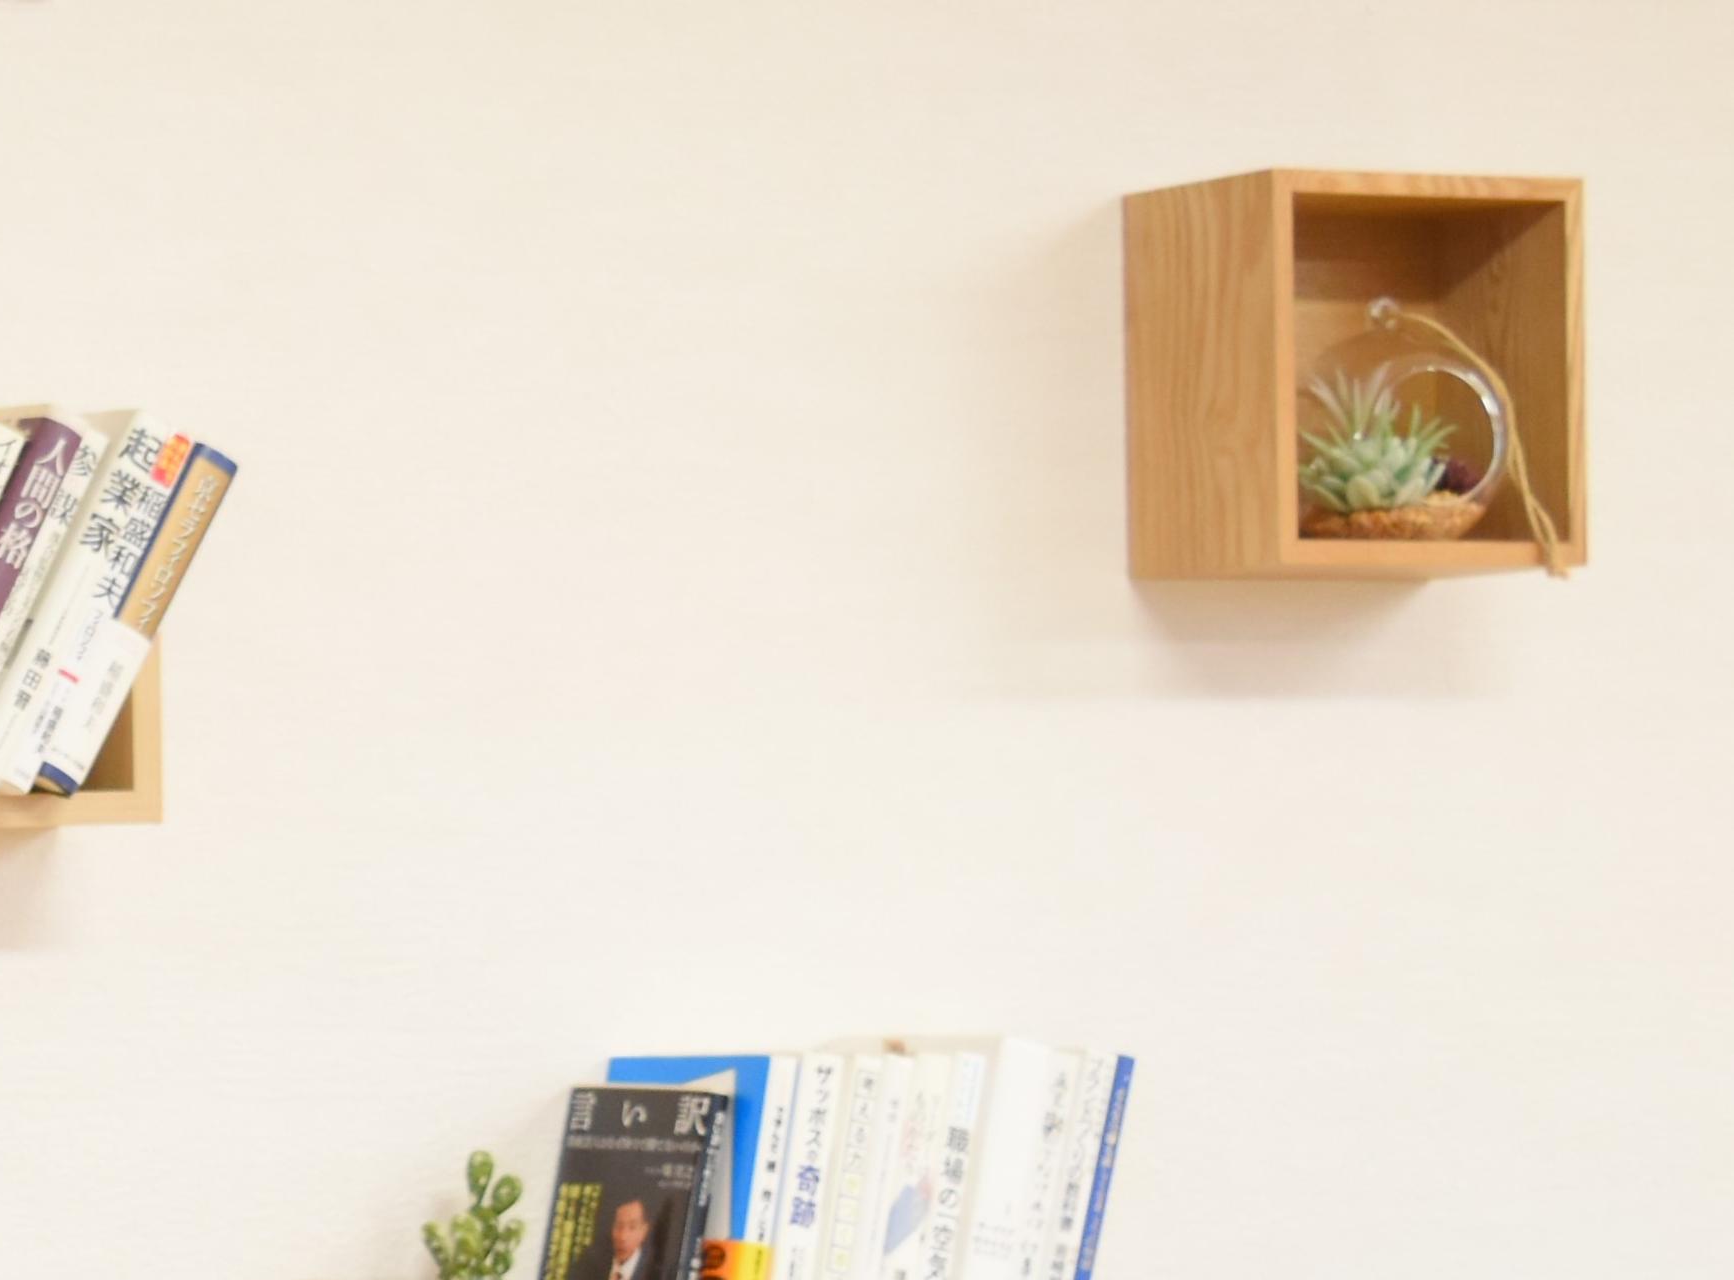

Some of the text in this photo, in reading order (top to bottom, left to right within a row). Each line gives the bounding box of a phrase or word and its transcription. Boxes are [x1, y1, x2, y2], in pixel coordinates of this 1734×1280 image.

[79, 426, 159, 555] 起業家
[92, 489, 167, 611] 稲盛和夫
[570, 1091, 711, 1136] 言い訳
